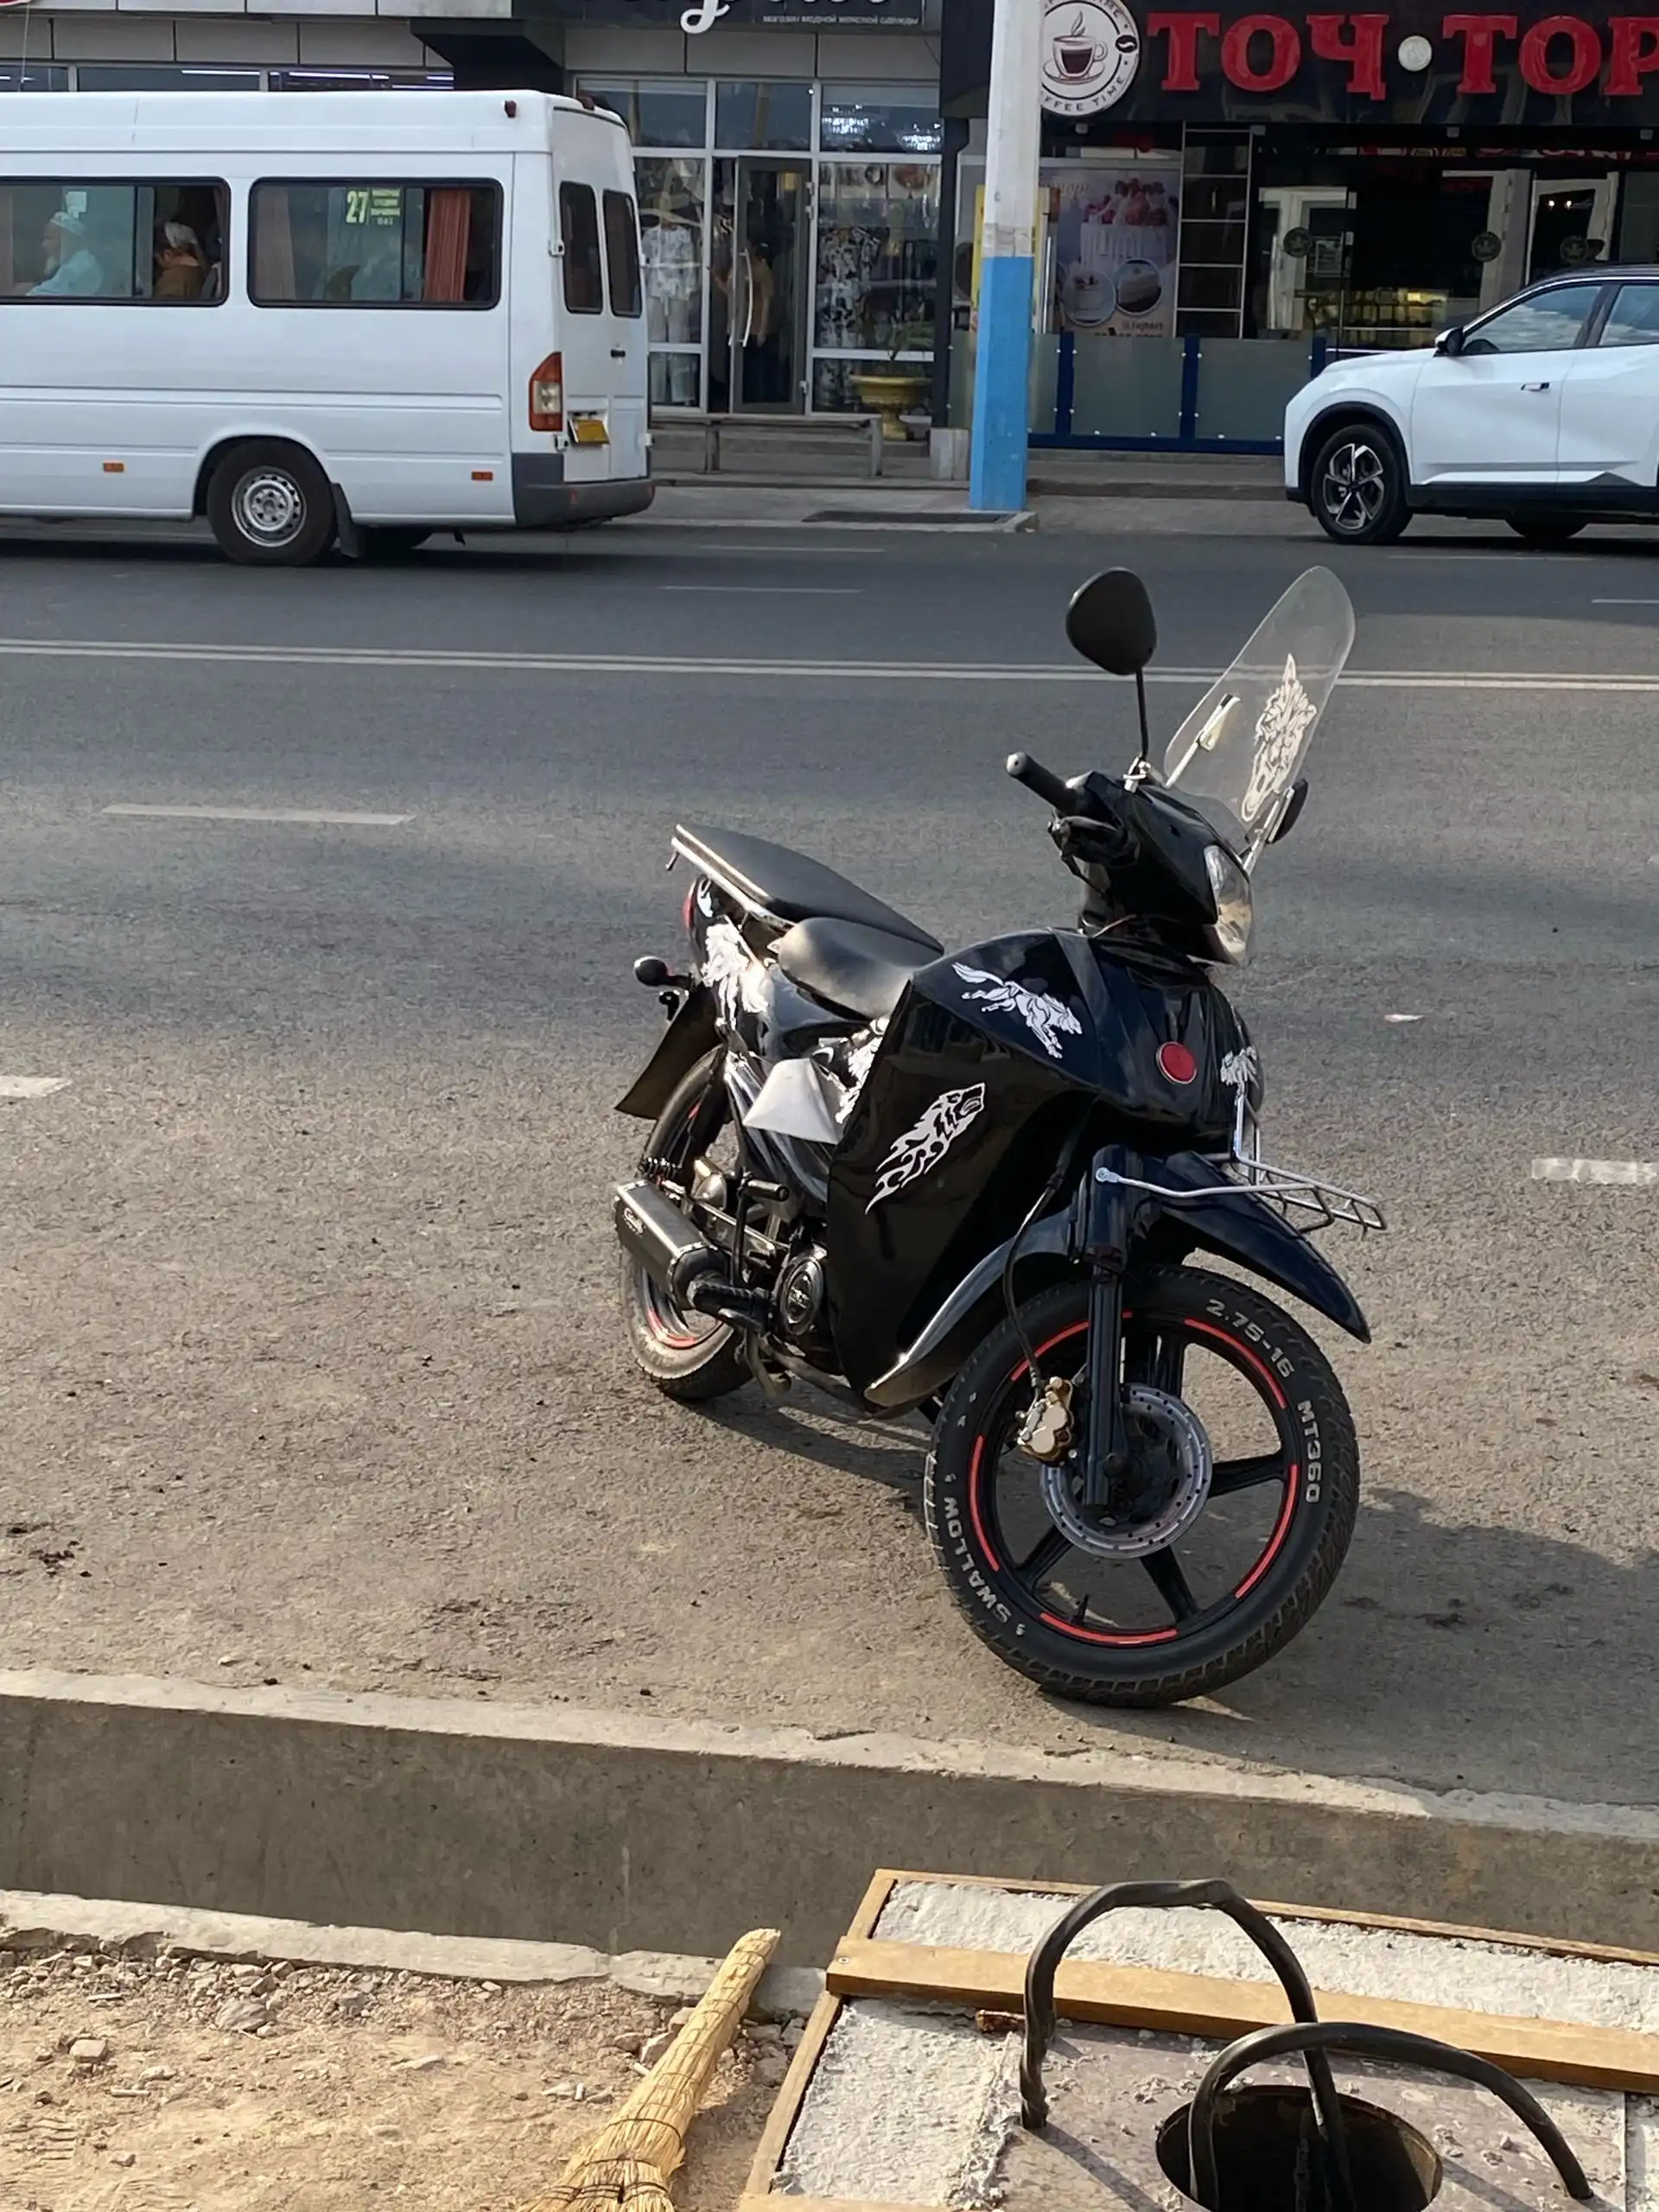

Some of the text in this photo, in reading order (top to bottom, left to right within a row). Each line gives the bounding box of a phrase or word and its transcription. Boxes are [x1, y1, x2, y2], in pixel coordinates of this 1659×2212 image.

[1147, 12, 1659, 101] ТОЧ ТОР
[346, 190, 369, 224] 27
[1206, 1299, 1295, 1378] 2.75-16
[1297, 1400, 1323, 1503] MT360
[944, 1497, 1012, 1623] SWALLOW
